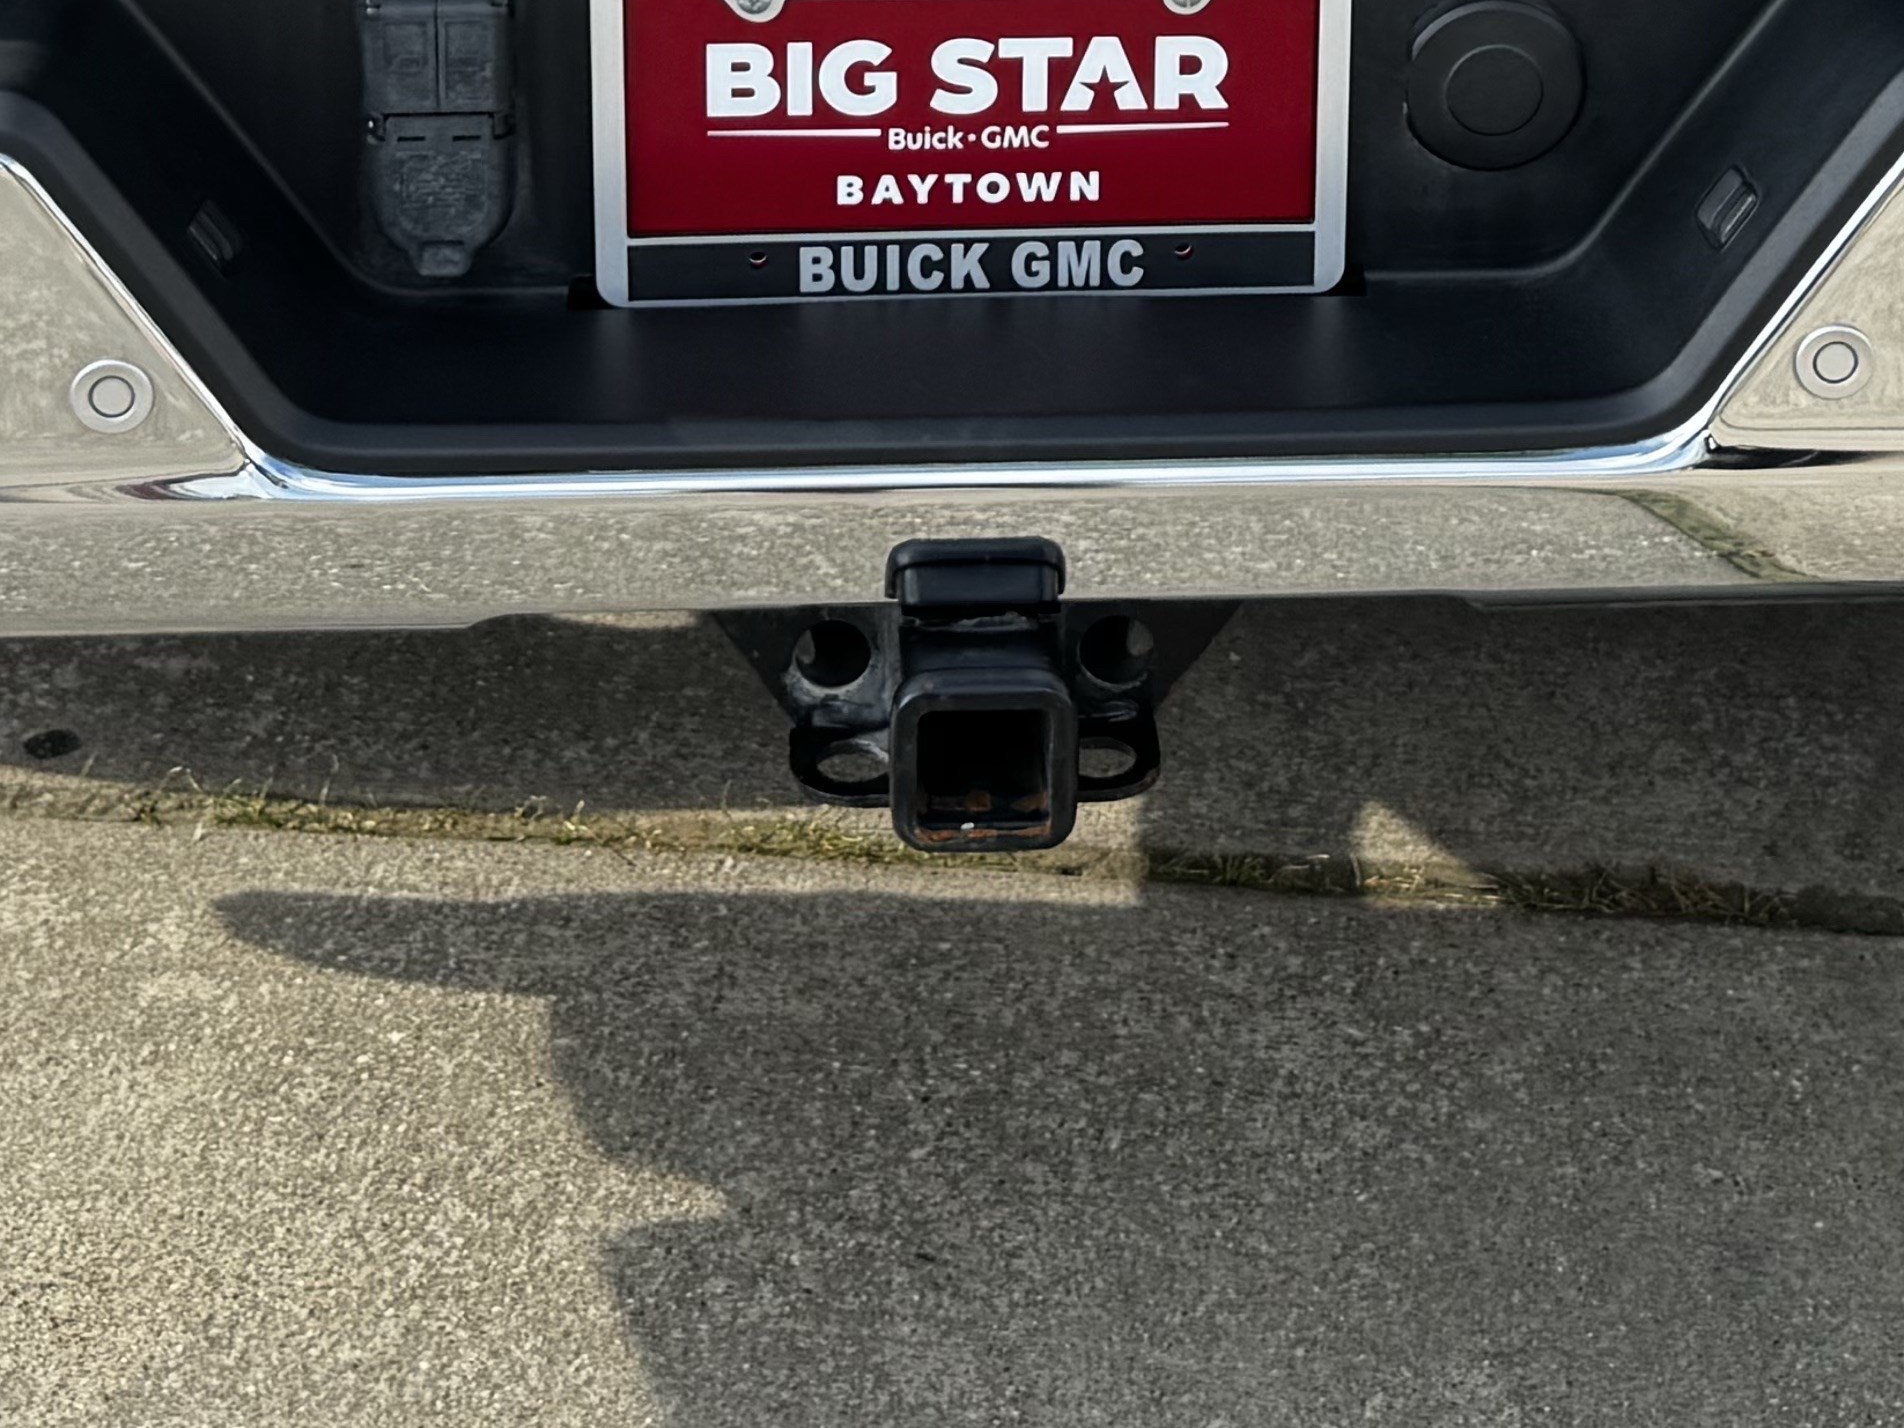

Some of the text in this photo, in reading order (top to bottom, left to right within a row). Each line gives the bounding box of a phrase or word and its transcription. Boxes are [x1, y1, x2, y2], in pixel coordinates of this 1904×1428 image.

[706, 36, 1229, 118] BIG STAR
[887, 124, 1051, 151] Buick GMC
[836, 170, 1100, 206] BAYTOWN
[799, 239, 1145, 293] BUICK GMC
